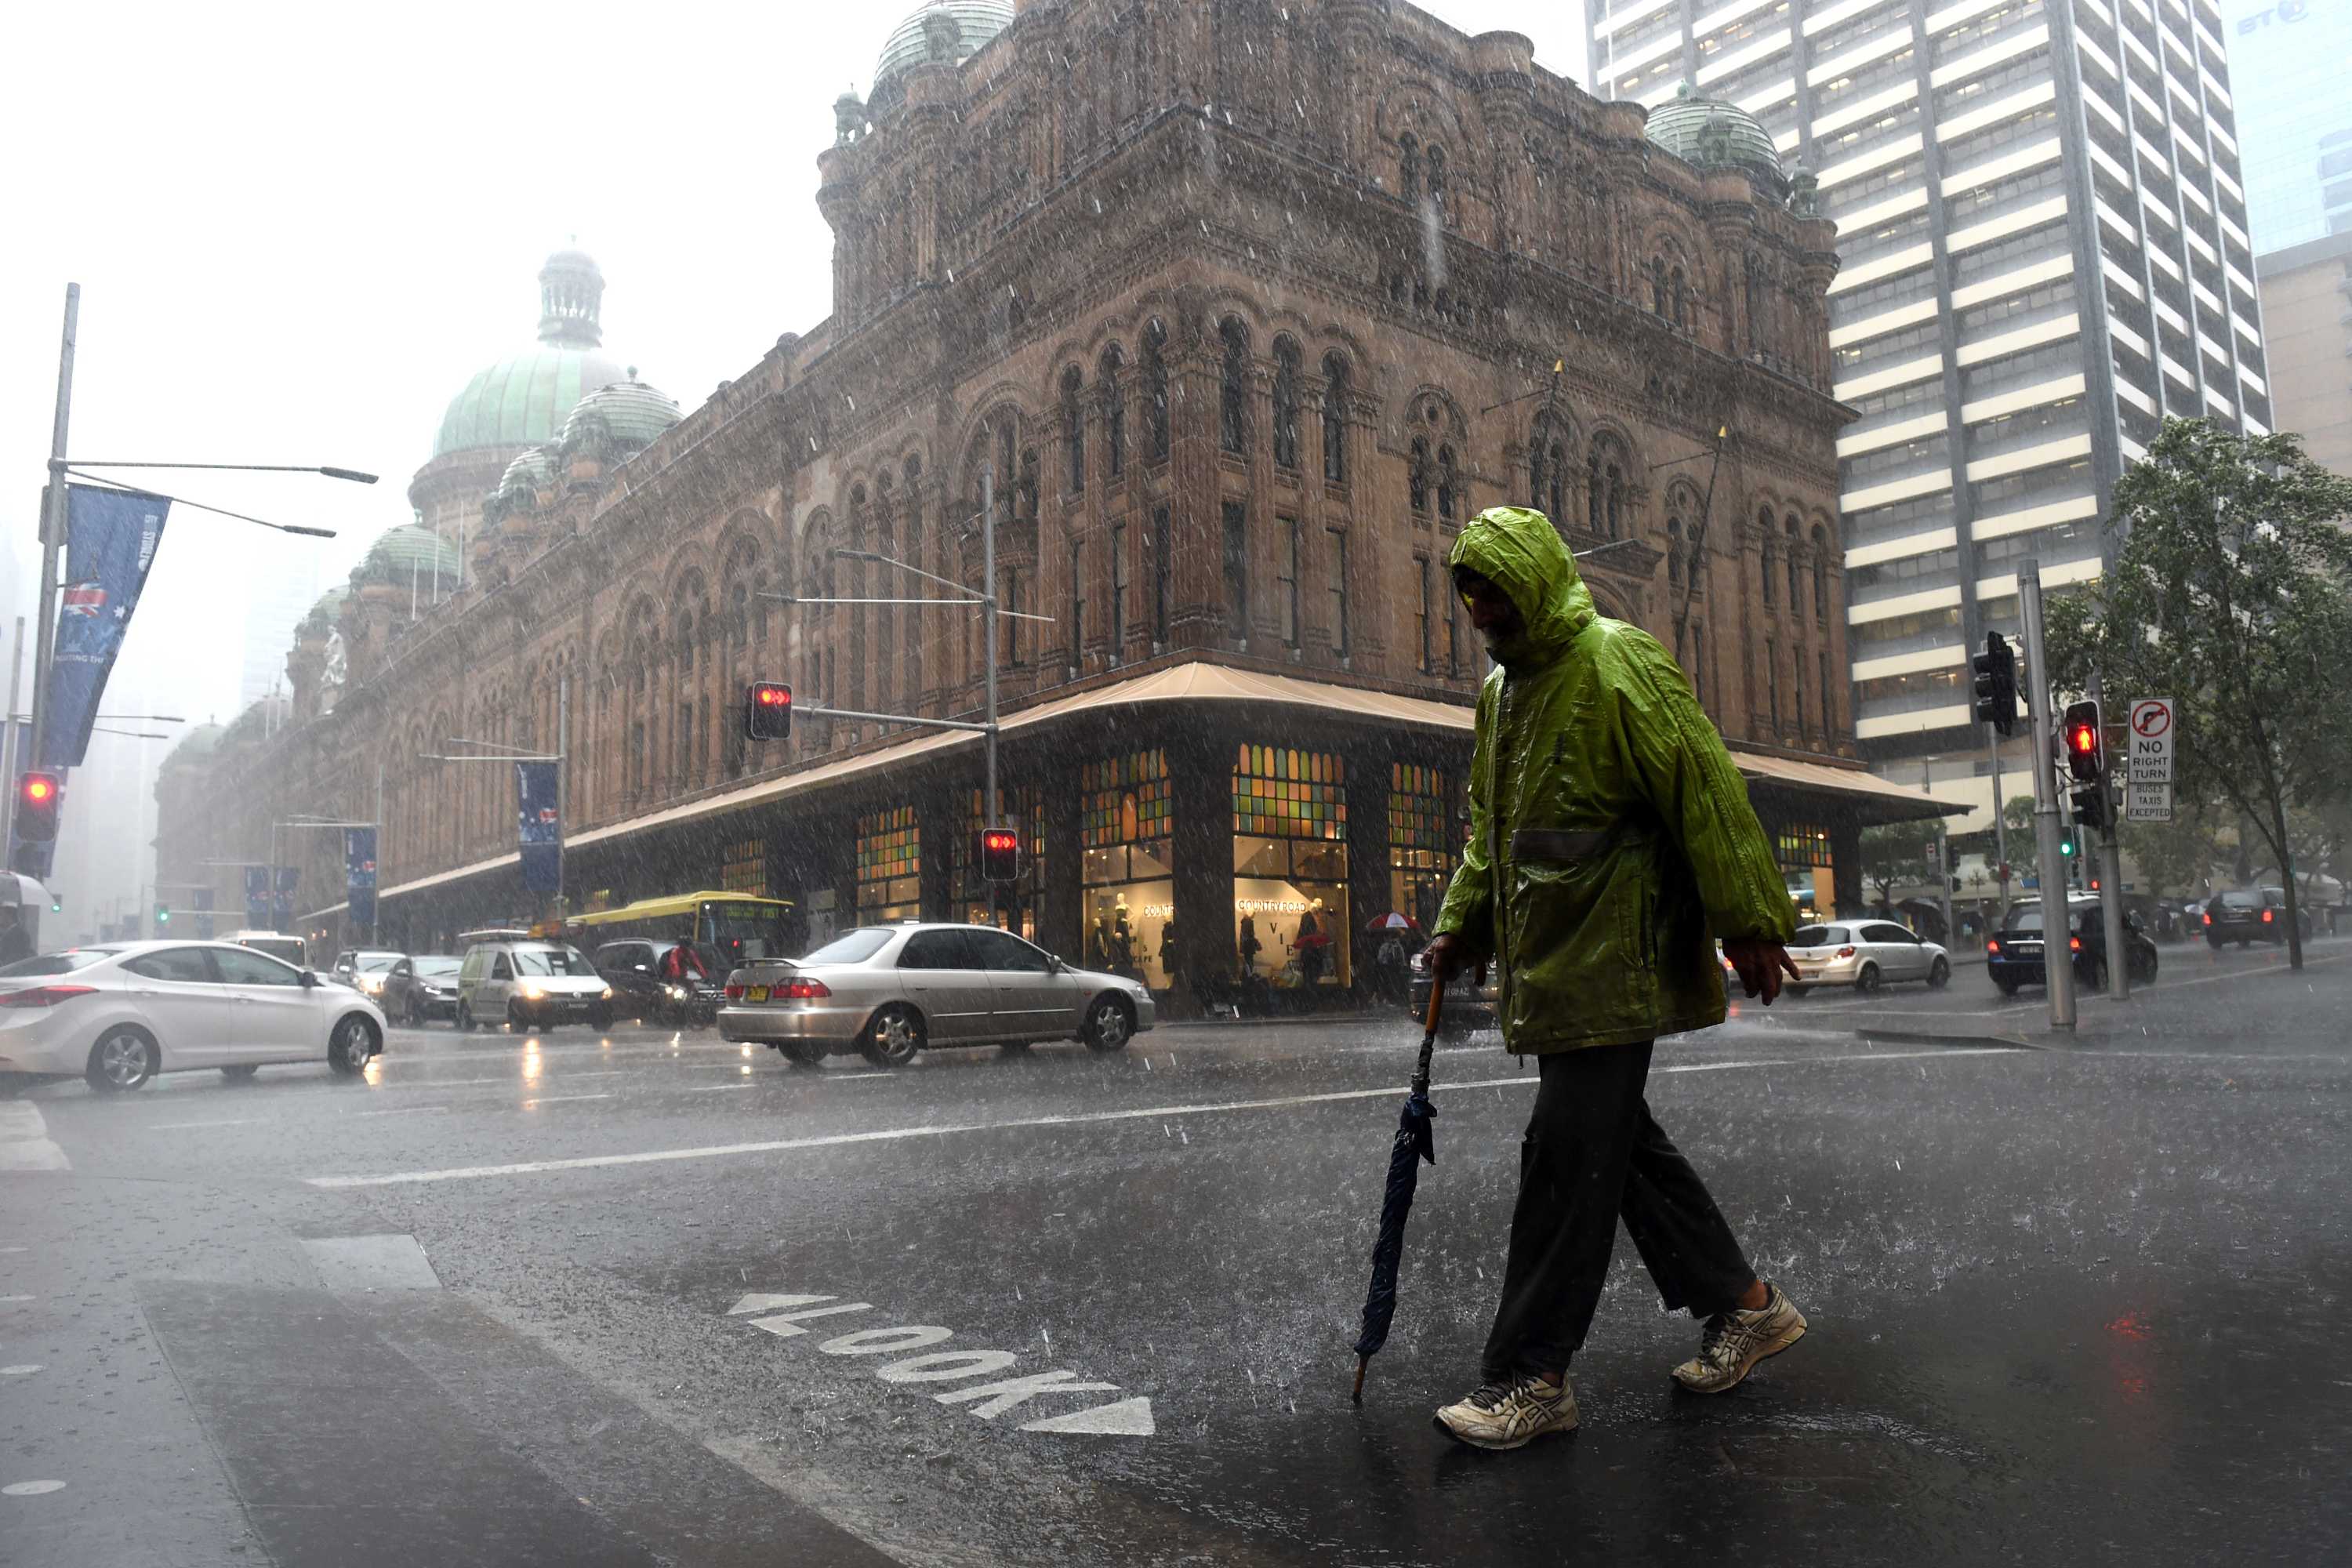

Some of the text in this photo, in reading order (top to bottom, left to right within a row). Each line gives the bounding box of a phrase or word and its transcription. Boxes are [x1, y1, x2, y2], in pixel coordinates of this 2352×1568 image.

[2139, 740, 2162, 753] NO
[2132, 757, 2168, 766] RIGHT
[2134, 770, 2166, 779] TURN
[2136, 783, 2163, 793] BUSES
[2129, 808, 2170, 817] EXCEPTED
[1239, 900, 1306, 912] COUNTRY ROAD
[747, 1301, 1122, 1420] LOOK
